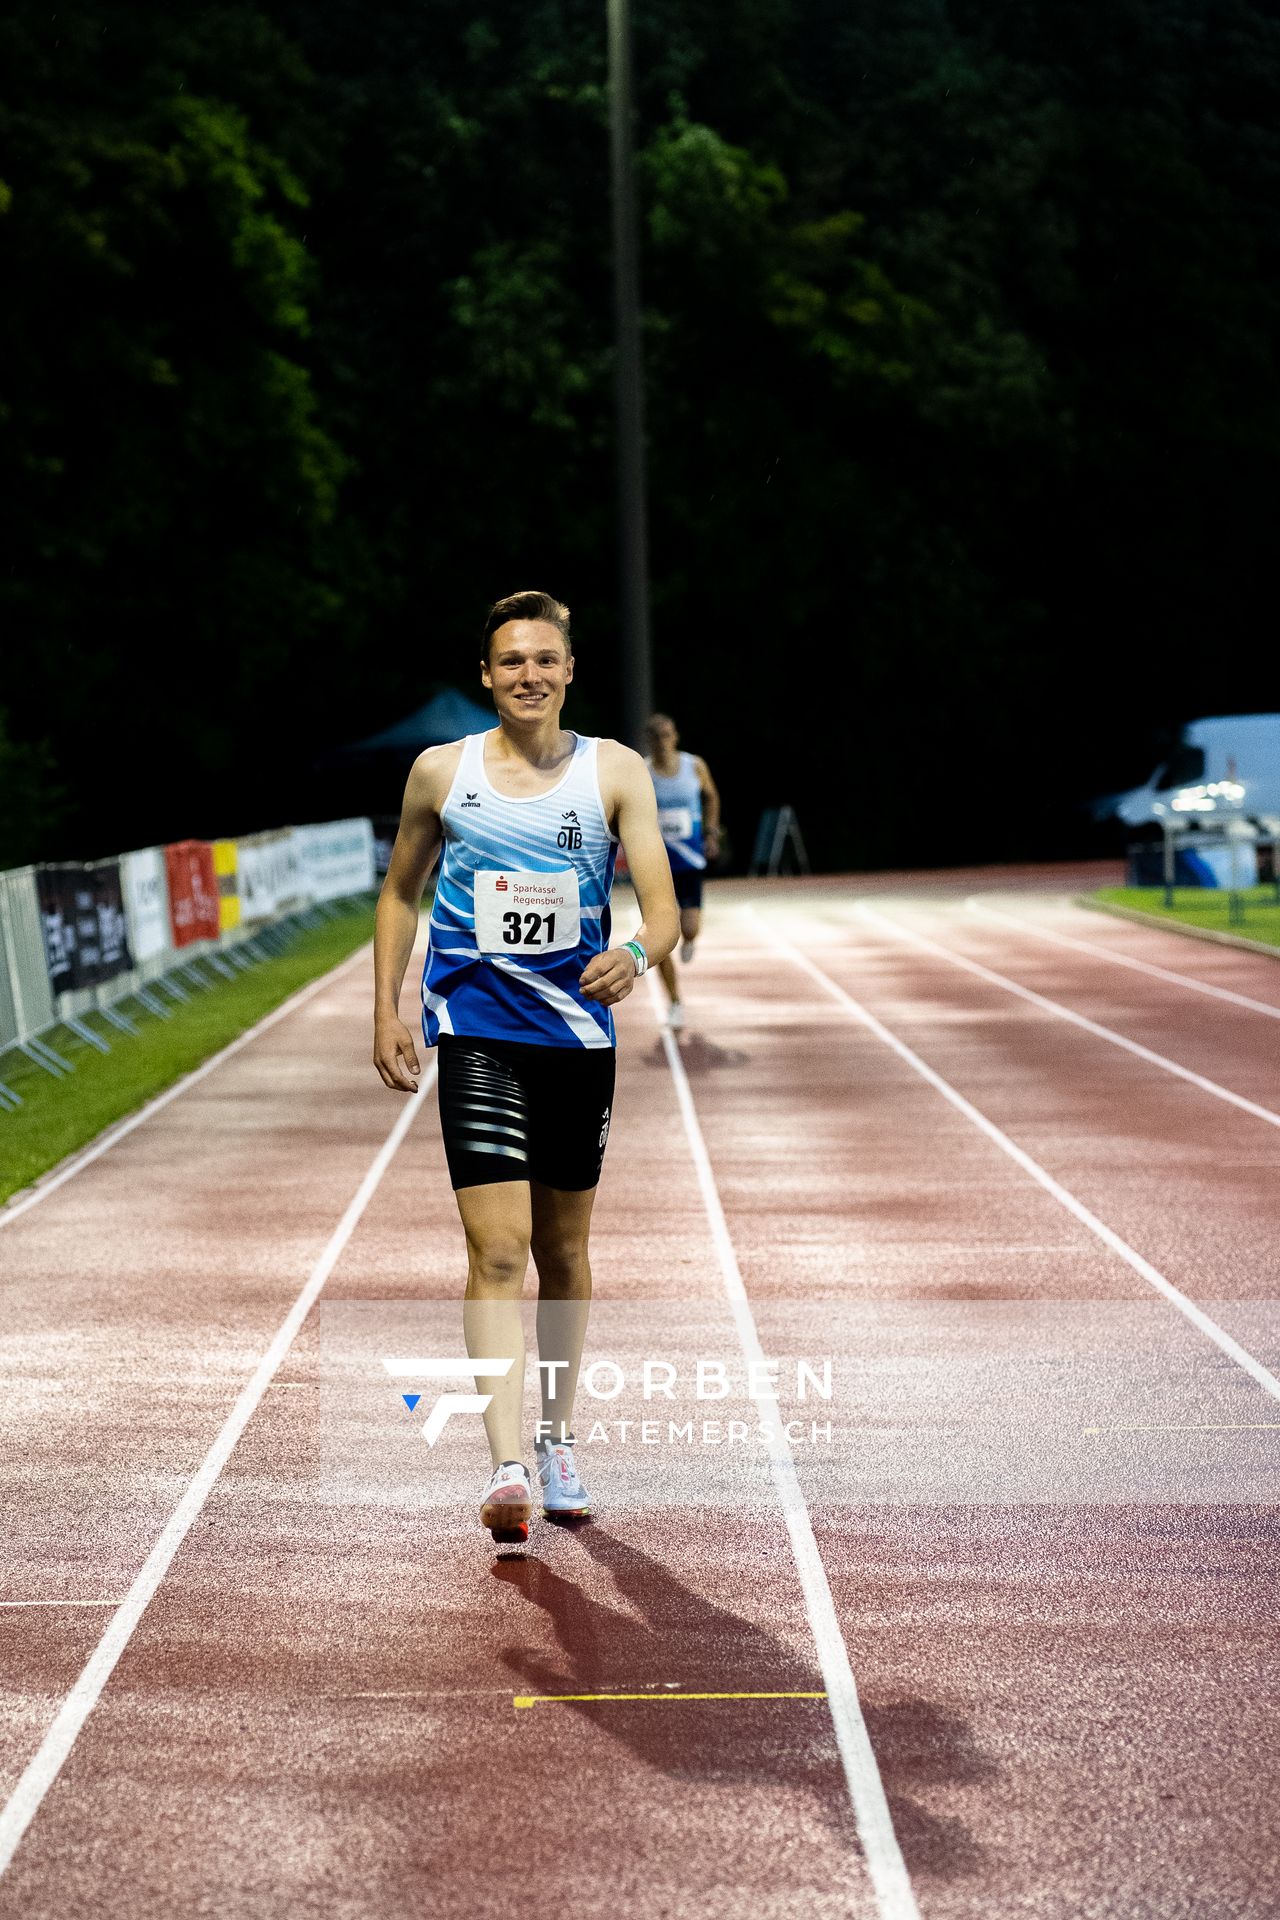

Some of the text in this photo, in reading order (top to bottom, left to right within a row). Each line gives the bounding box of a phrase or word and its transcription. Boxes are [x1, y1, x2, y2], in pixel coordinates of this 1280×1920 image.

[557, 826, 583, 850] OTB
[513, 884, 557, 894] Sparkasse
[513, 895, 564, 906] Regensburg
[502, 911, 556, 945] 321
